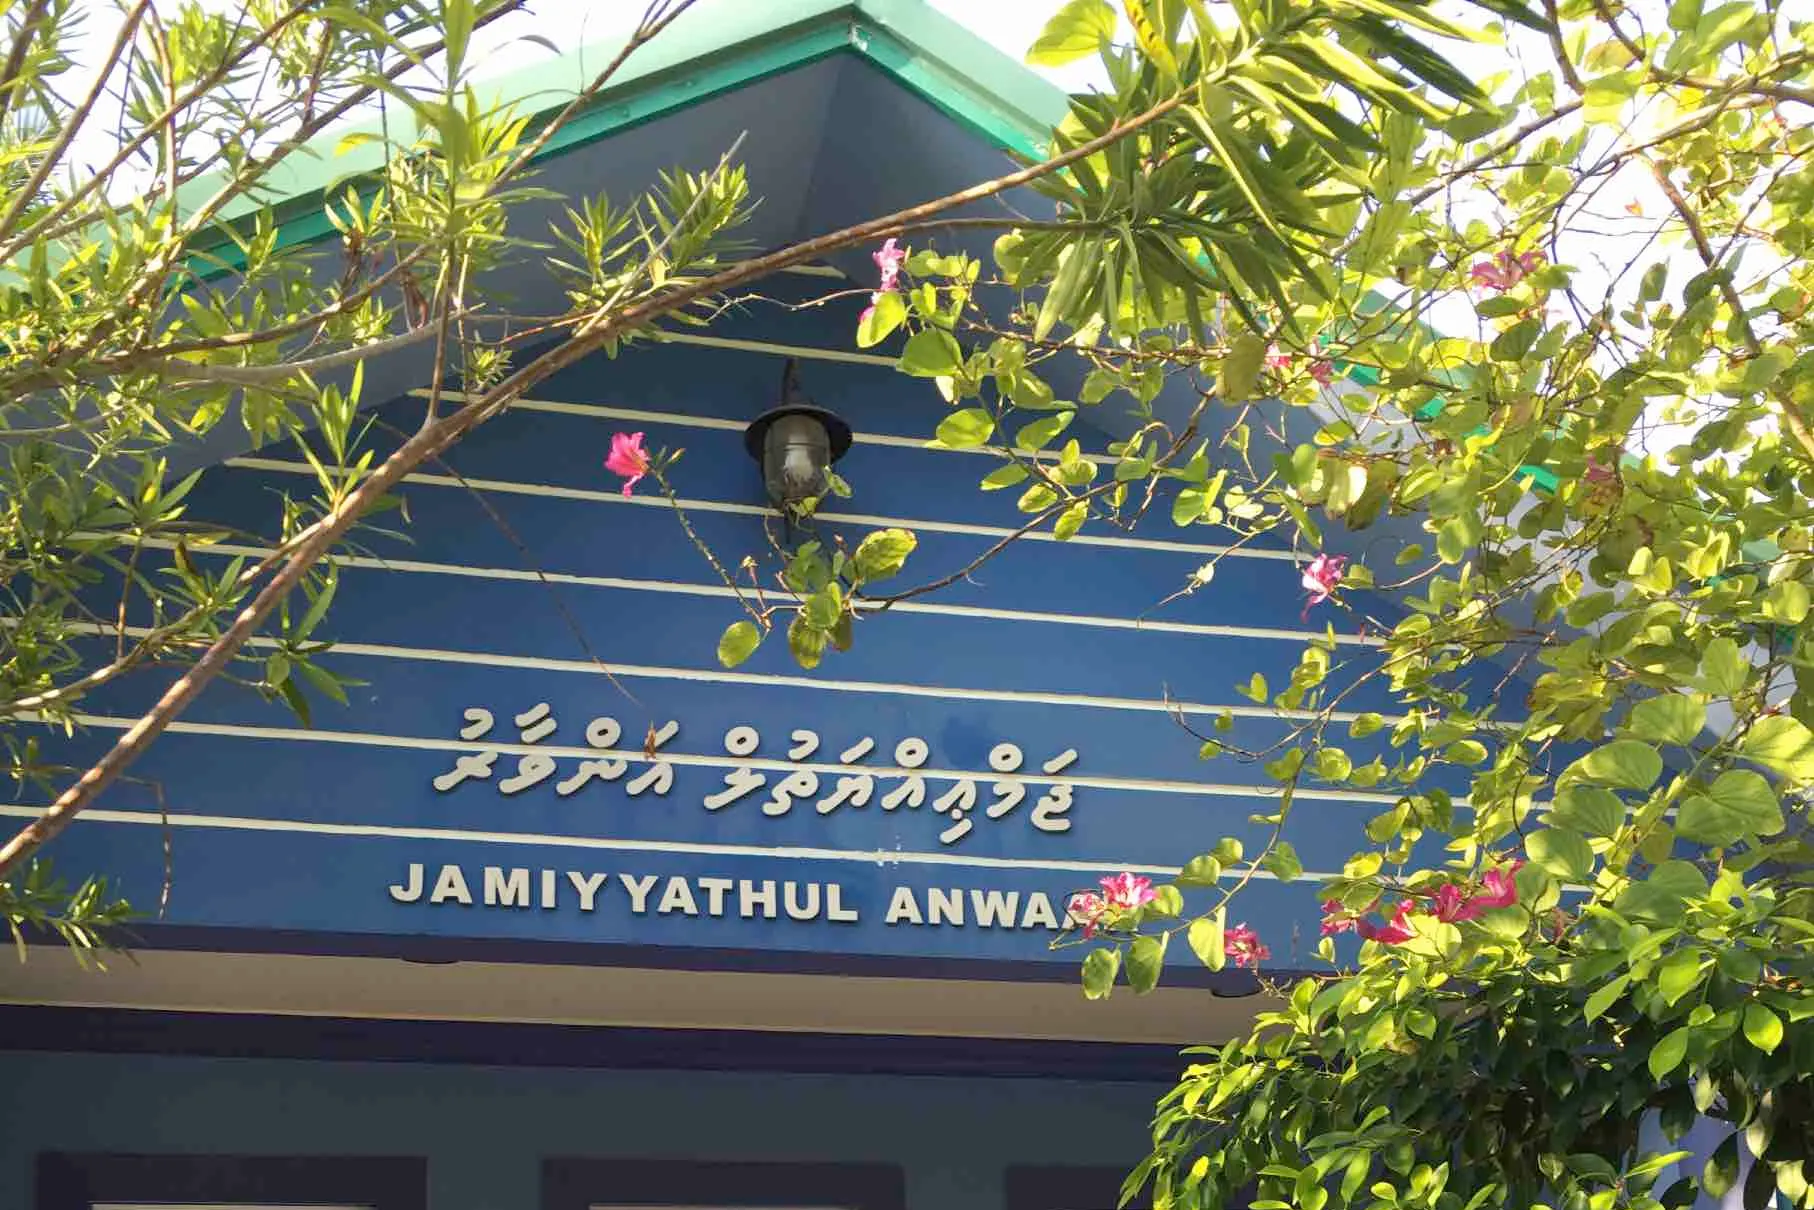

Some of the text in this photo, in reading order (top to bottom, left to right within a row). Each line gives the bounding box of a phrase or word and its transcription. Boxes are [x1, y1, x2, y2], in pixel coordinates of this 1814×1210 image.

[433, 702, 680, 796] އަންވާރު
[389, 863, 1138, 930] JAMIYYATHUL ANWA
